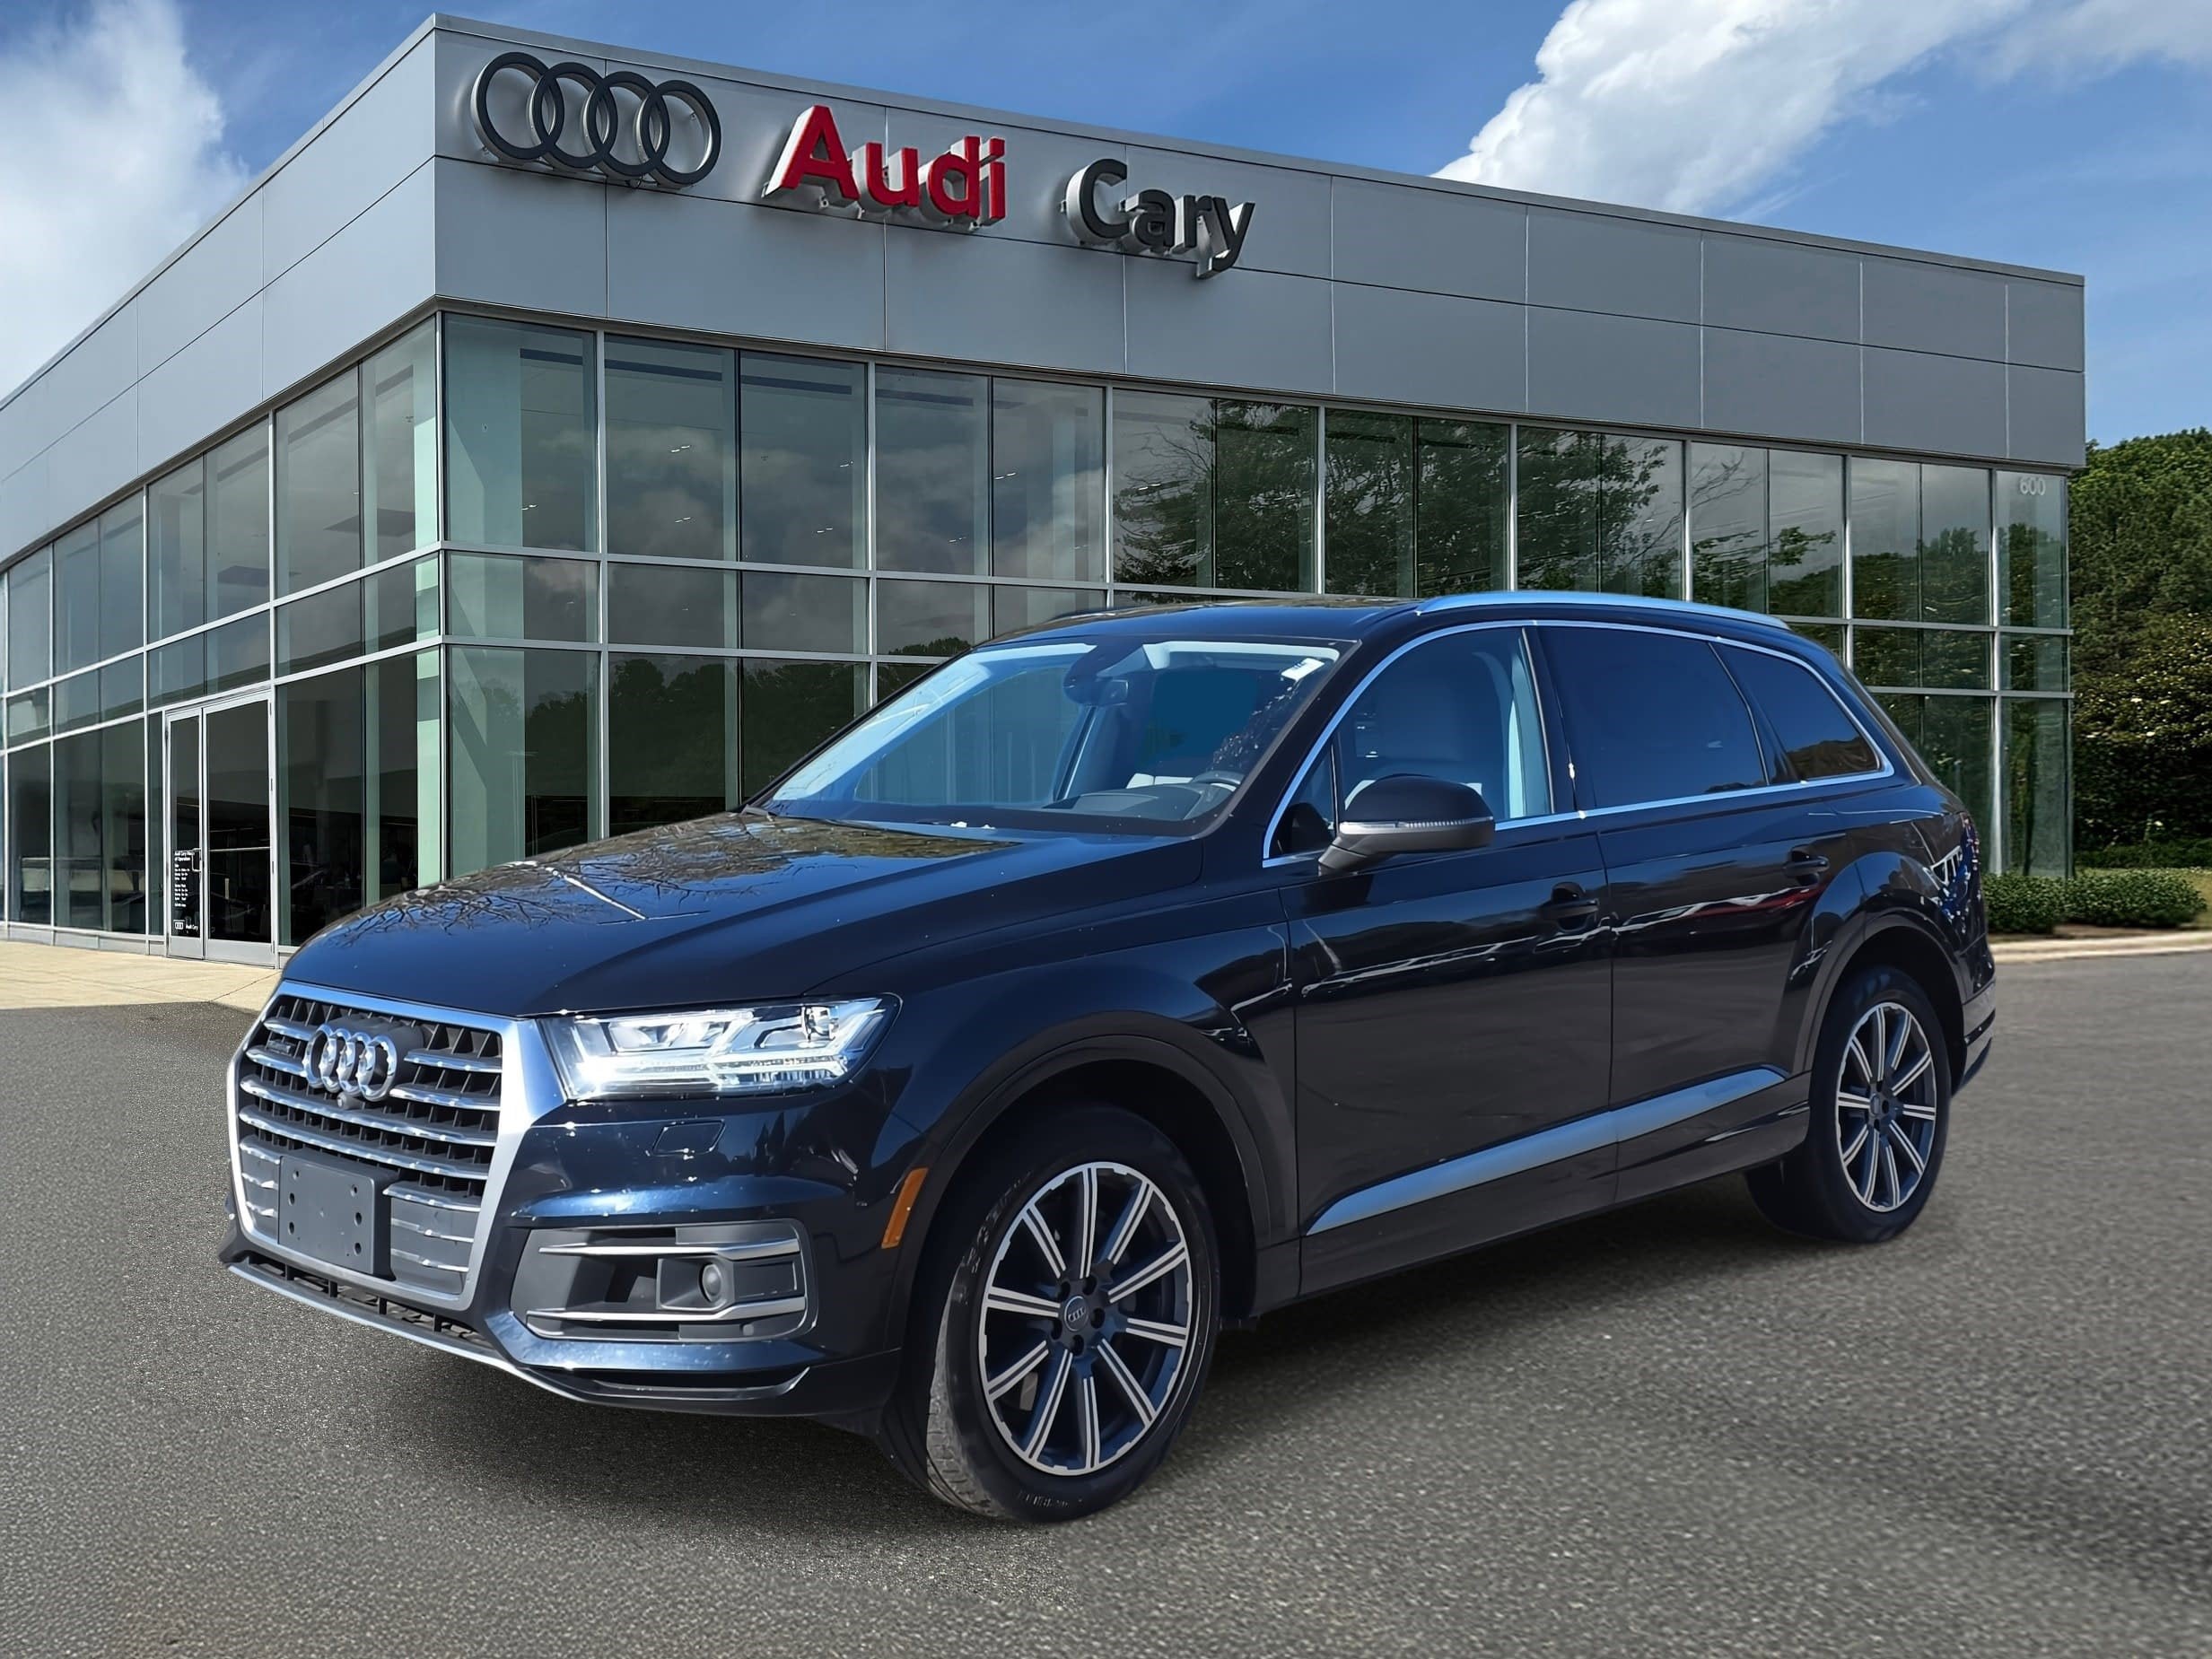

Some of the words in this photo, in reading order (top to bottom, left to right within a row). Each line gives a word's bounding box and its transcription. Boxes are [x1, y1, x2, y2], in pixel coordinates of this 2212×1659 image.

[766, 104, 1006, 226] Audi
[1064, 158, 1255, 279] Cary
[2019, 476, 2046, 496] 600
